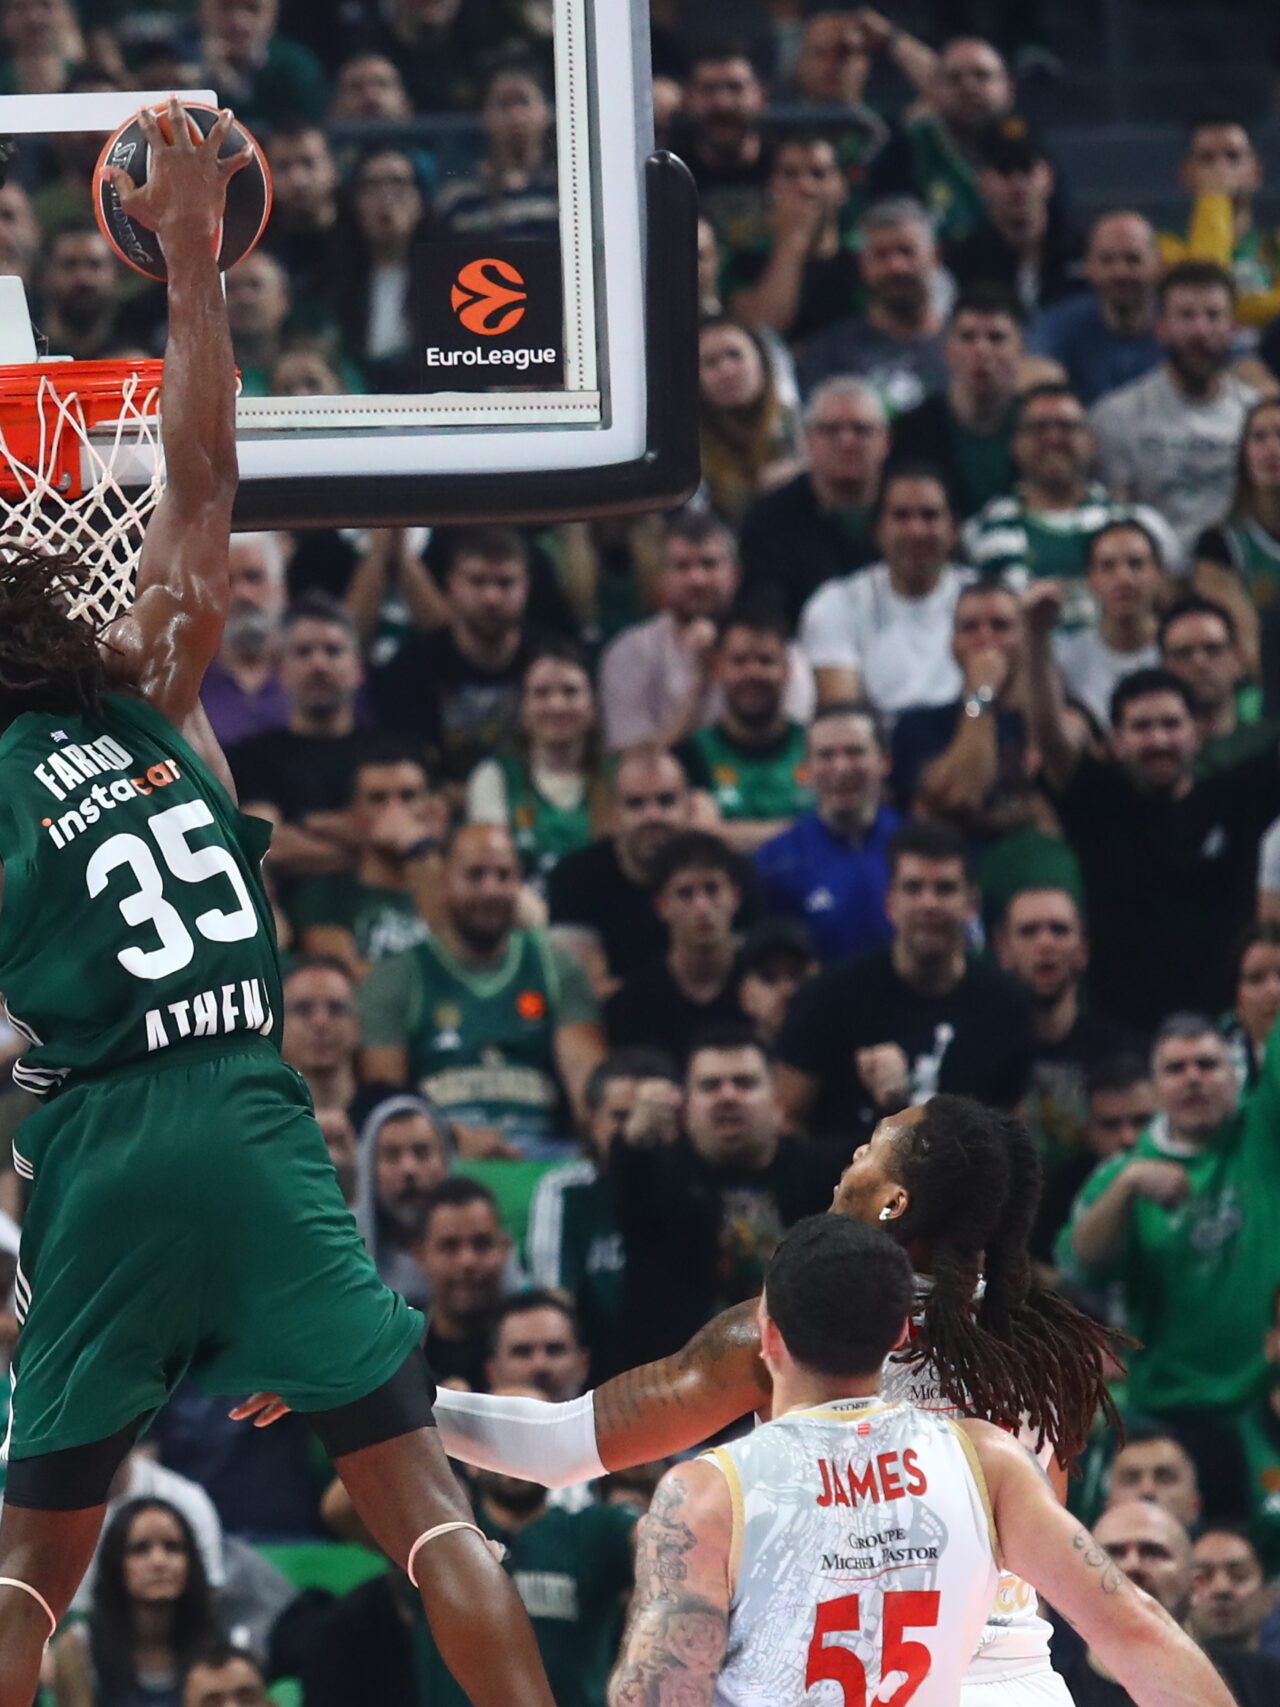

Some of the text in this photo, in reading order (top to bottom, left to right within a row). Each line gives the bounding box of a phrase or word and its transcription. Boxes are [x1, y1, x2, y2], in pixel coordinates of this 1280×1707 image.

[426, 346, 557, 371] EuroLeague
[41, 758, 181, 850] instacar
[86, 799, 259, 980] 35
[816, 1448, 928, 1508] JAMES
[805, 1590, 941, 1707] 55
